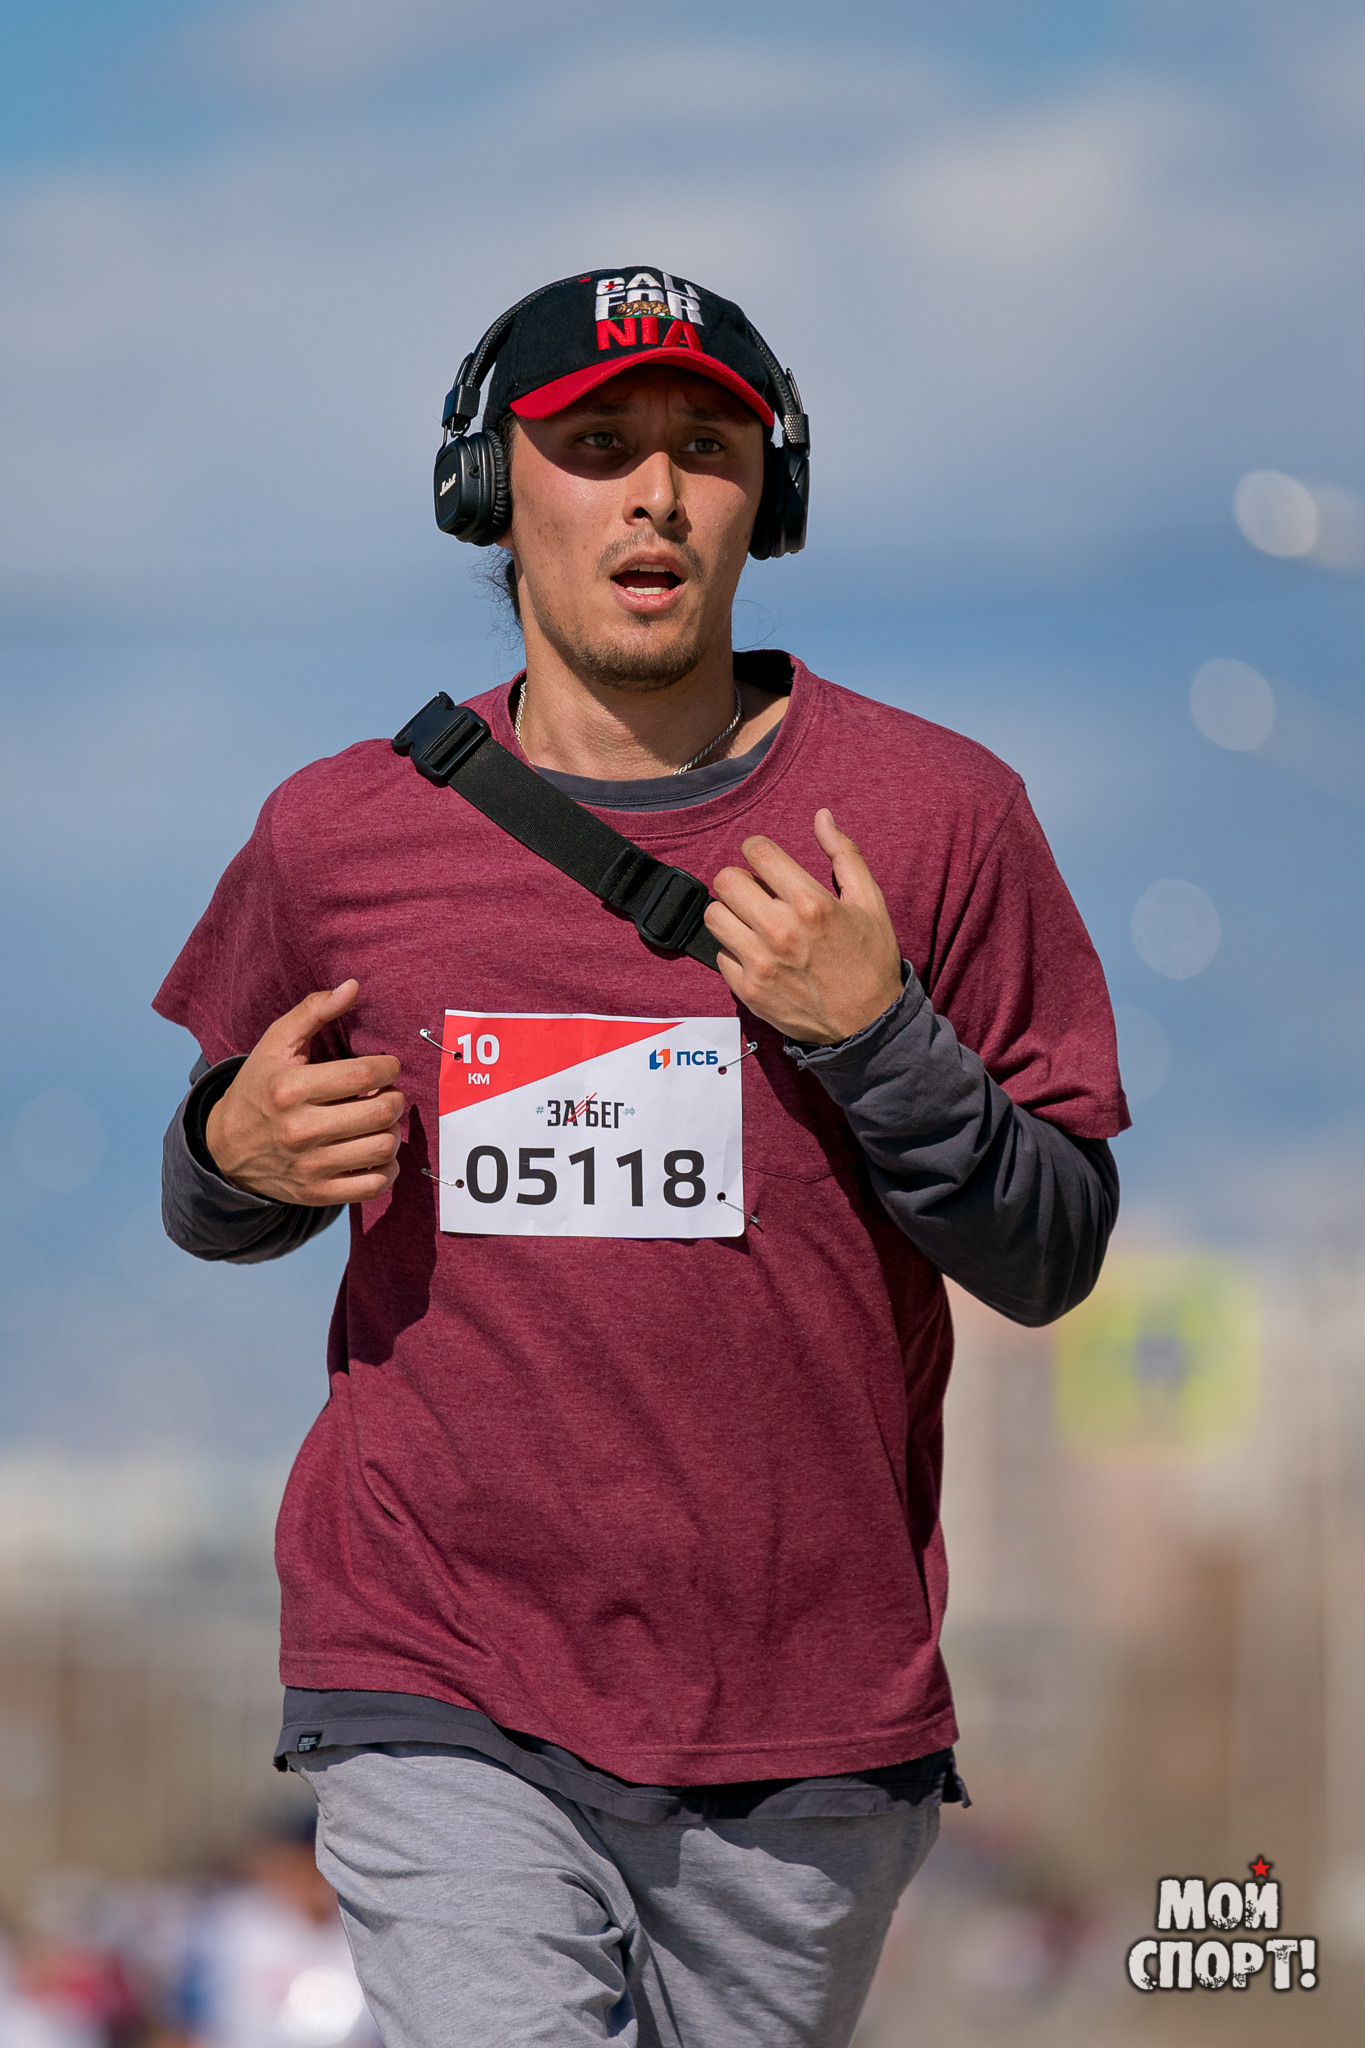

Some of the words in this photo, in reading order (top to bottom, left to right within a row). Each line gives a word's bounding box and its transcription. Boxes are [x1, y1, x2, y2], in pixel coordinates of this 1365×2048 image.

[596, 316, 703, 353] NIA
[456, 1033, 500, 1065] 10
[676, 1050, 719, 1067] ПСБ
[466, 1145, 706, 1208] 05118
